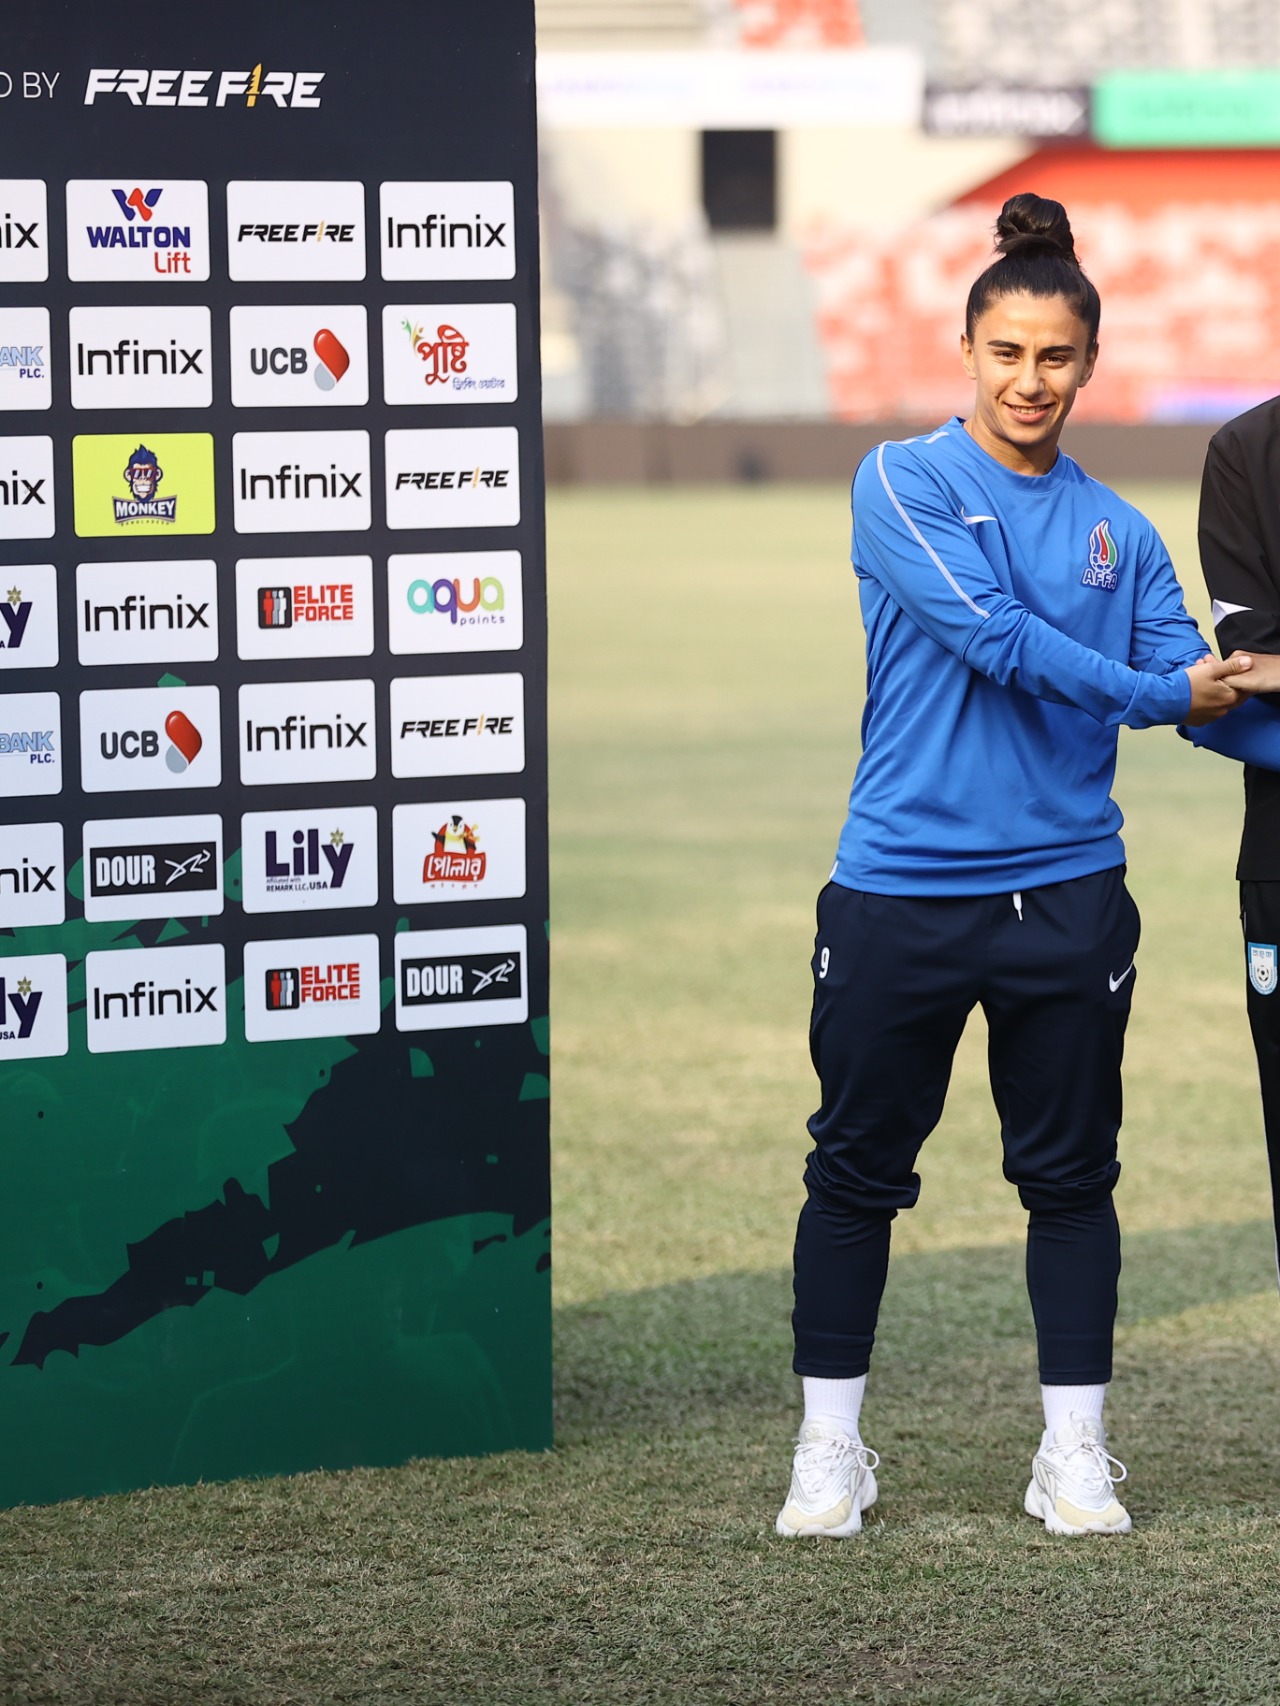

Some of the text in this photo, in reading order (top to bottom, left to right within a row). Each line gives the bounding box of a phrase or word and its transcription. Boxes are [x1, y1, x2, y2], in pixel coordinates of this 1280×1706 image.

[23, 72, 60, 98] BY
[84, 69, 213, 106] FREE
[86, 226, 191, 248] WALTON
[237, 224, 300, 242] FREE
[388, 214, 506, 248] Infinix
[154, 252, 191, 273] Lift
[77, 339, 203, 375] Infinix
[250, 347, 308, 375] UCB
[19, 368, 44, 378] PLC.
[240, 464, 362, 500] Infinix
[395, 471, 456, 491] FREE
[115, 500, 175, 517] MONKEY
[1082, 568, 1118, 590] AFFA
[294, 584, 353, 604] ELITE
[407, 577, 505, 625] aqua
[84, 594, 210, 632] Infinix
[294, 605, 353, 621] FORCE
[460, 616, 505, 627] paints
[246, 714, 367, 752] Infinix
[400, 719, 460, 739] FREE
[0, 730, 55, 754] BANK
[100, 730, 159, 760] UCB
[30, 753, 55, 764] PLC.
[265, 829, 354, 888] Lily
[96, 855, 156, 887] DOUR
[266, 884, 293, 892] REMARK
[309, 880, 328, 890] USA
[301, 963, 360, 985] ELITE
[819, 947, 829, 979] 9
[301, 984, 360, 1002] FORCE
[406, 966, 463, 997] DOUR
[94, 978, 218, 1020] Infinix
